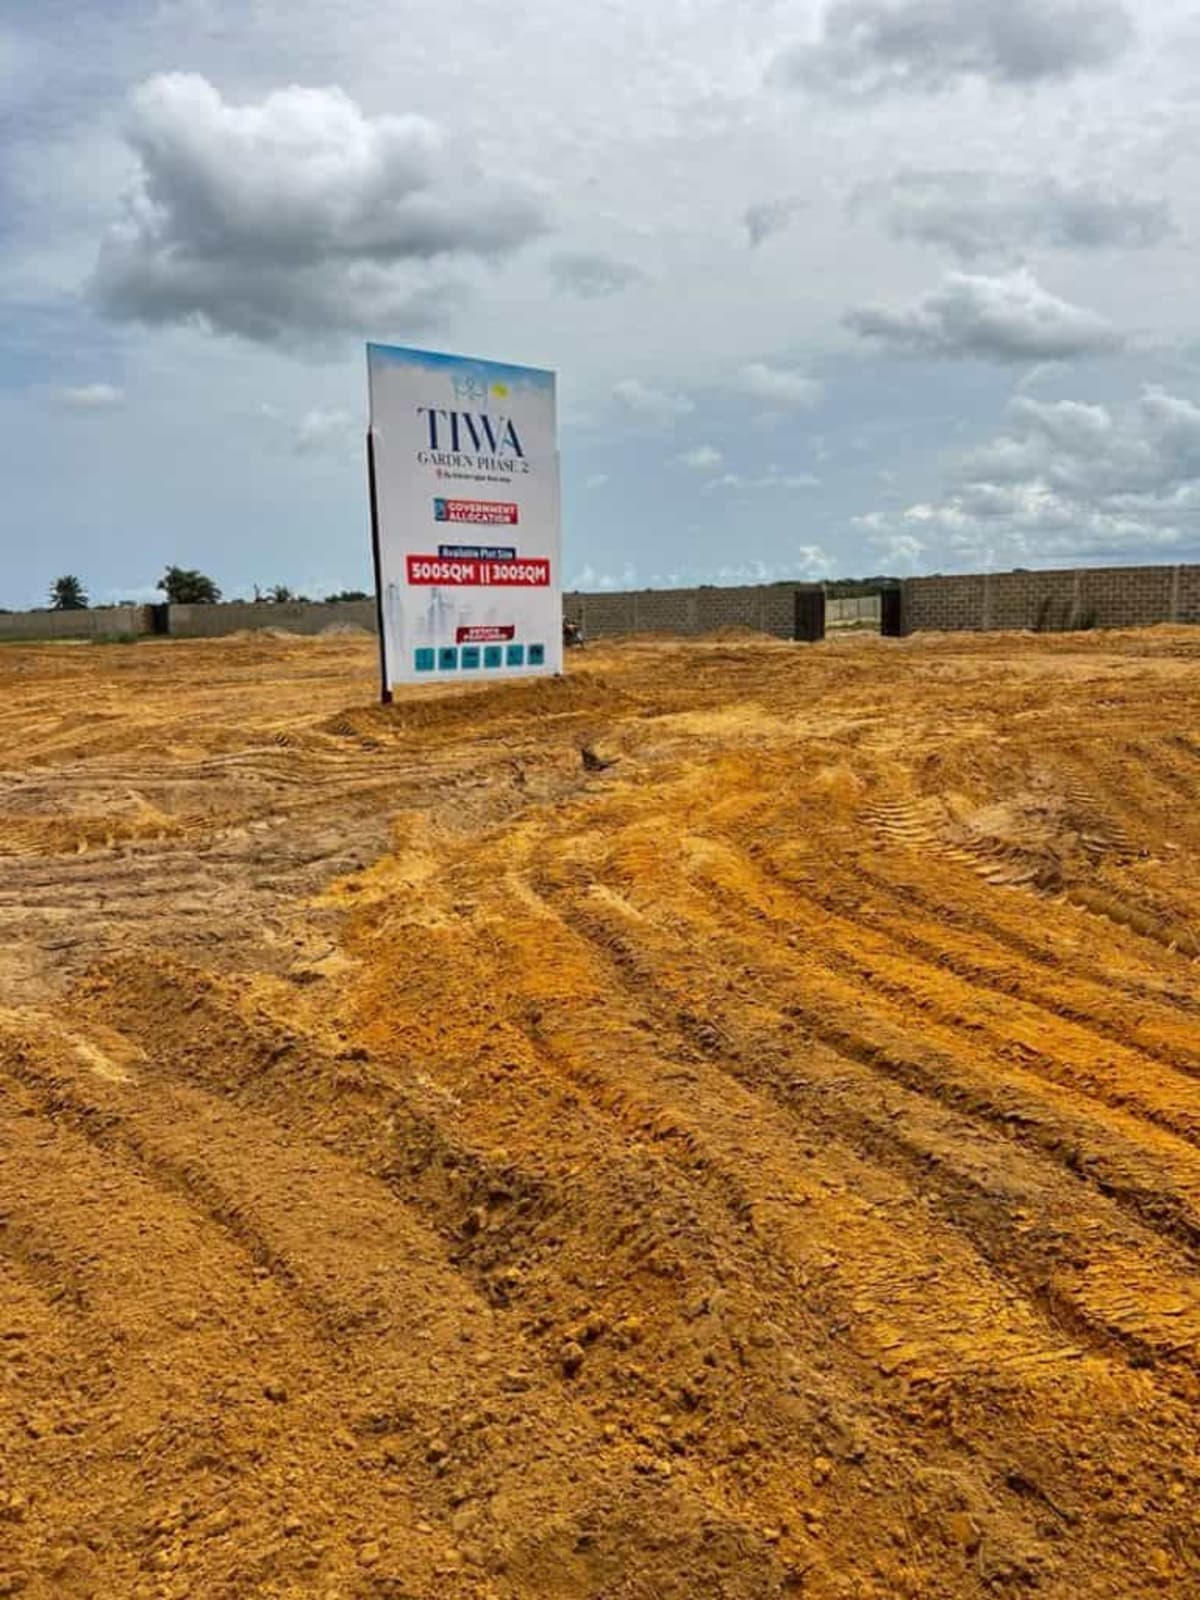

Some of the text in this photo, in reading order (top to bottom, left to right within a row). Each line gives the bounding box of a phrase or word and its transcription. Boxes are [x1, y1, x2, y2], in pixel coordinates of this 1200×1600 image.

[416, 407, 524, 458] TIWA
[416, 451, 529, 474] GARDEN PHASE 2
[411, 562, 474, 582] 500SQM
[493, 564, 546, 583] 300SQM
